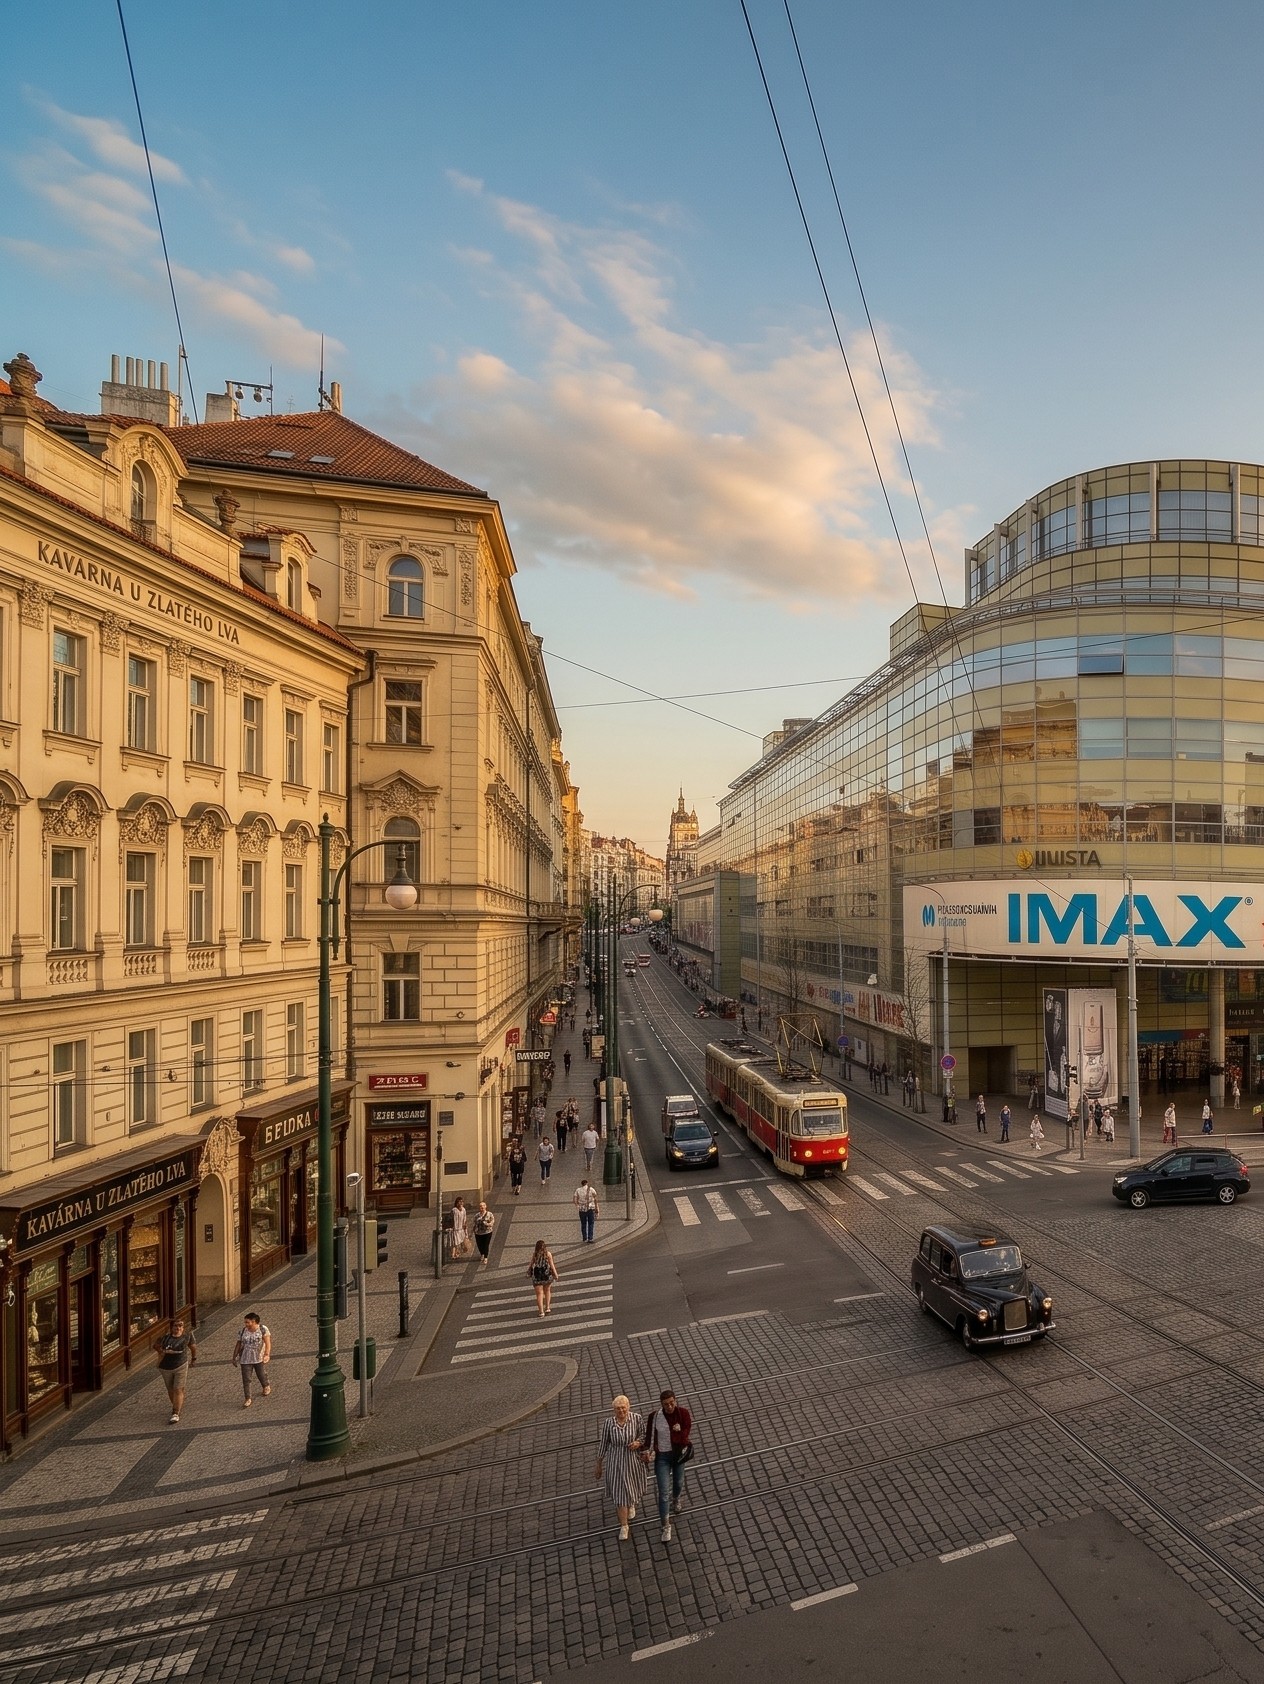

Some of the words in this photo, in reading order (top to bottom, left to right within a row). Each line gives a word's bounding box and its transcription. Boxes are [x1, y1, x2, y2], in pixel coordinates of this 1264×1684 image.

[130, 582, 140, 601] U
[147, 590, 213, 632] ZLATÉHO
[218, 621, 239, 645] LVA
[1008, 893, 1246, 948] IMAX
[26, 1202, 93, 1240] KAVÁRNA
[96, 1191, 105, 1211] U
[108, 1170, 164, 1207] ZLATÉHO
[167, 1161, 186, 1183] LVA
